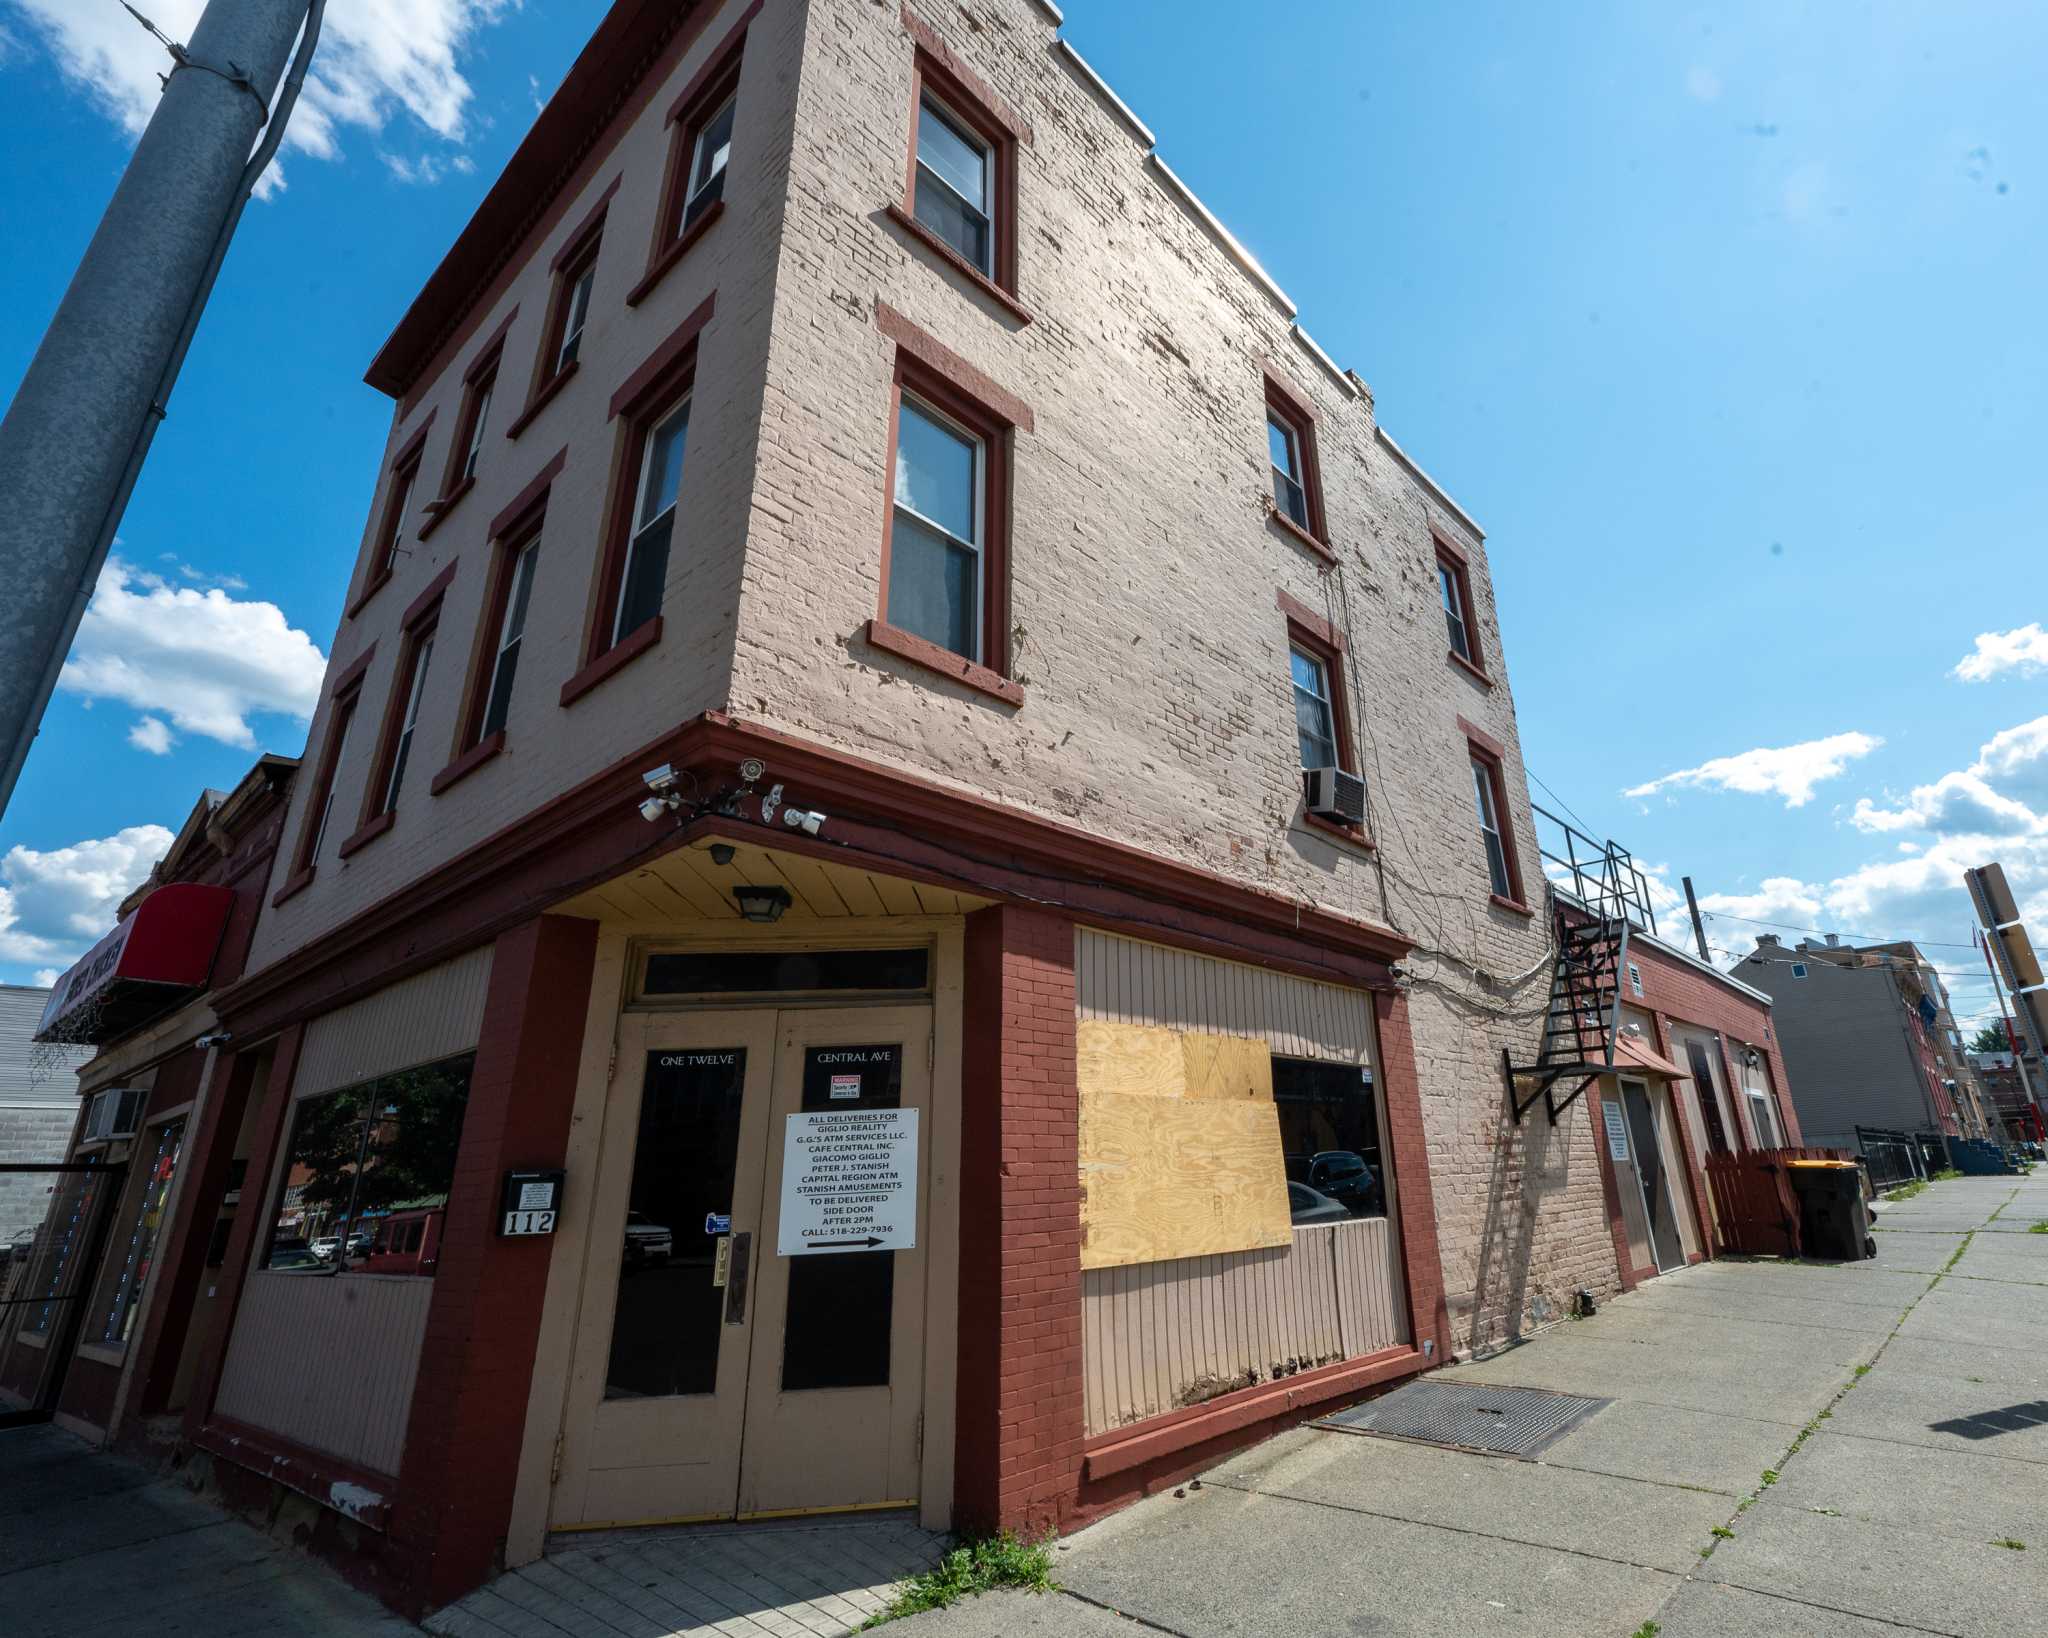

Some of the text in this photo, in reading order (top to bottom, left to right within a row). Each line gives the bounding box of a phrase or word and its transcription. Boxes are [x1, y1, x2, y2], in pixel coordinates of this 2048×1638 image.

[660, 1054, 735, 1066] ONE TWELVE
[817, 1051, 892, 1063] CENTRAL AVE
[827, 1115, 877, 1123] DELIVERIES
[817, 1123, 888, 1133] GIGLIO REALITY
[823, 1135, 843, 1143] ATM
[845, 1133, 888, 1141] SERVICES
[889, 1132, 907, 1140] LLC.
[833, 1144, 874, 1152] CENTRAL
[876, 1142, 895, 1150] INC.
[812, 1152, 890, 1163] GIACOMO GIGLIO
[812, 1165, 840, 1173] PETER
[850, 1162, 889, 1171] STANISH
[801, 1175, 840, 1183] CAPITAL
[841, 1173, 876, 1181] REGION
[796, 1182, 902, 1194] STANISH AMUSEMENTS
[810, 1194, 889, 1206] TO BE DELIVERED
[823, 1205, 874, 1215] SIDE DOOR
[508, 1213, 552, 1233] 112
[822, 1216, 874, 1226] AFTER 2PM
[801, 1225, 894, 1237] CALL: 518-229-7936
